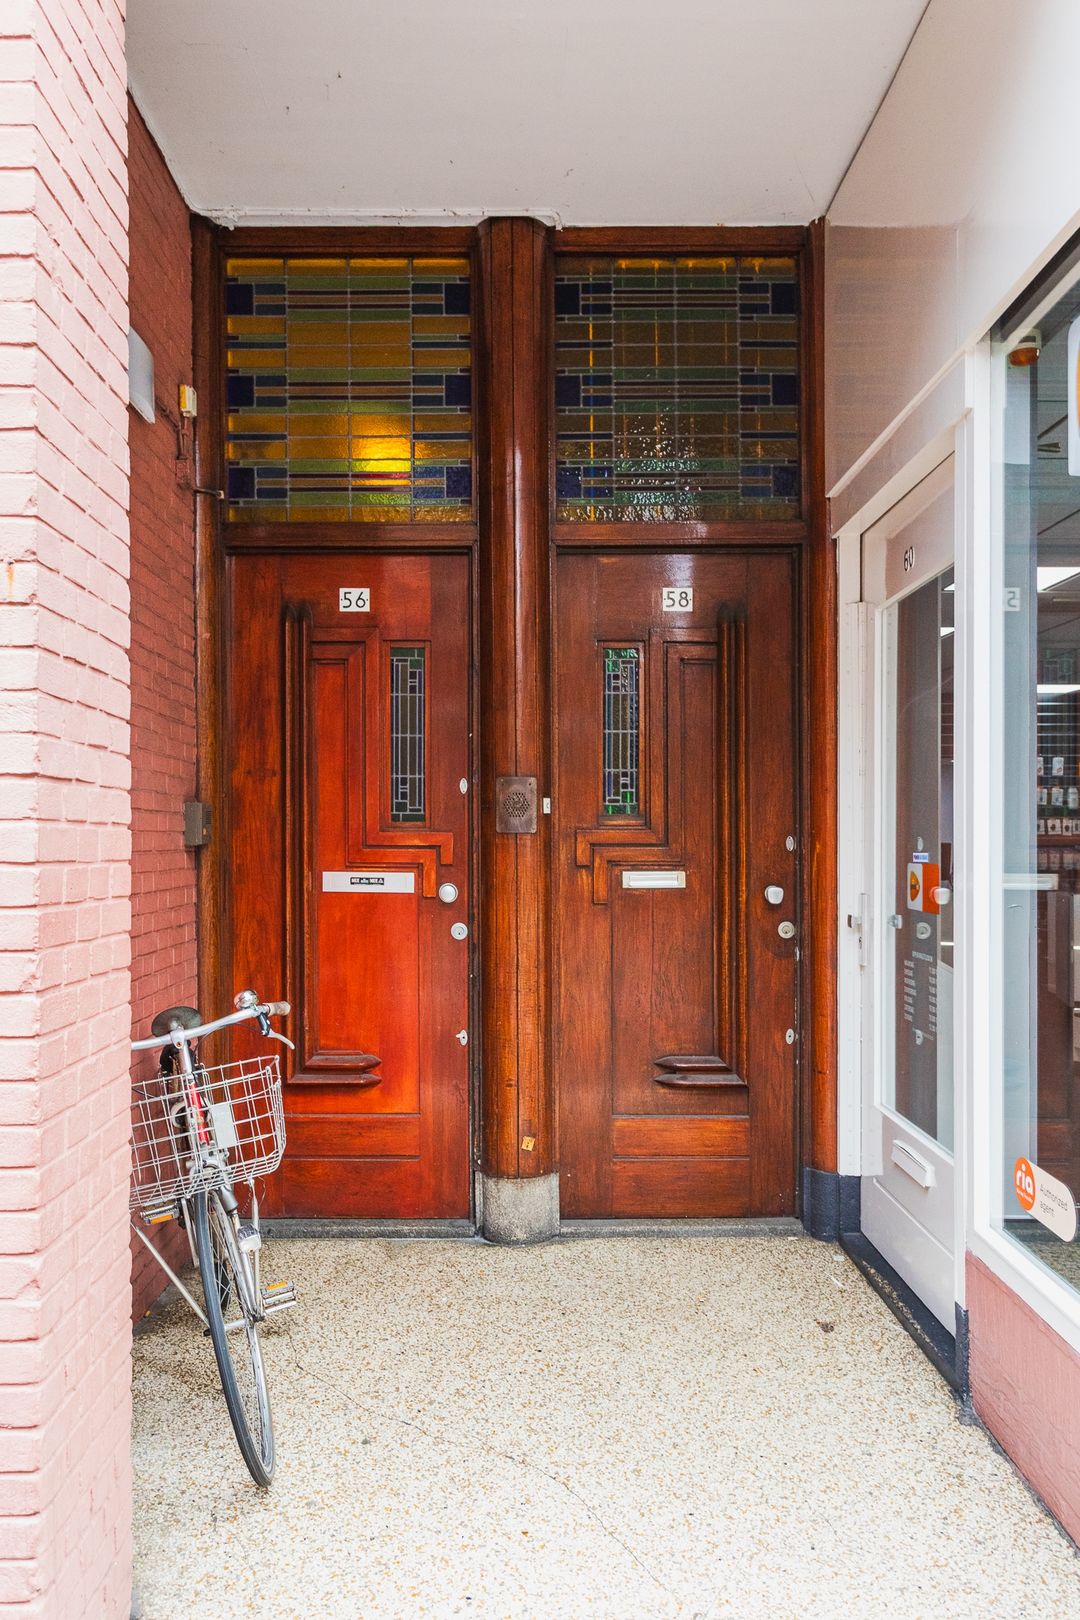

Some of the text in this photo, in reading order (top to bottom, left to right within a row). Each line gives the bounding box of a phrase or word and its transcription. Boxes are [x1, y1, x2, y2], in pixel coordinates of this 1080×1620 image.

[903, 546, 914, 571] 60
[342, 591, 366, 608] 56
[665, 591, 689, 608] 58
[1016, 1163, 1034, 1197] ria
